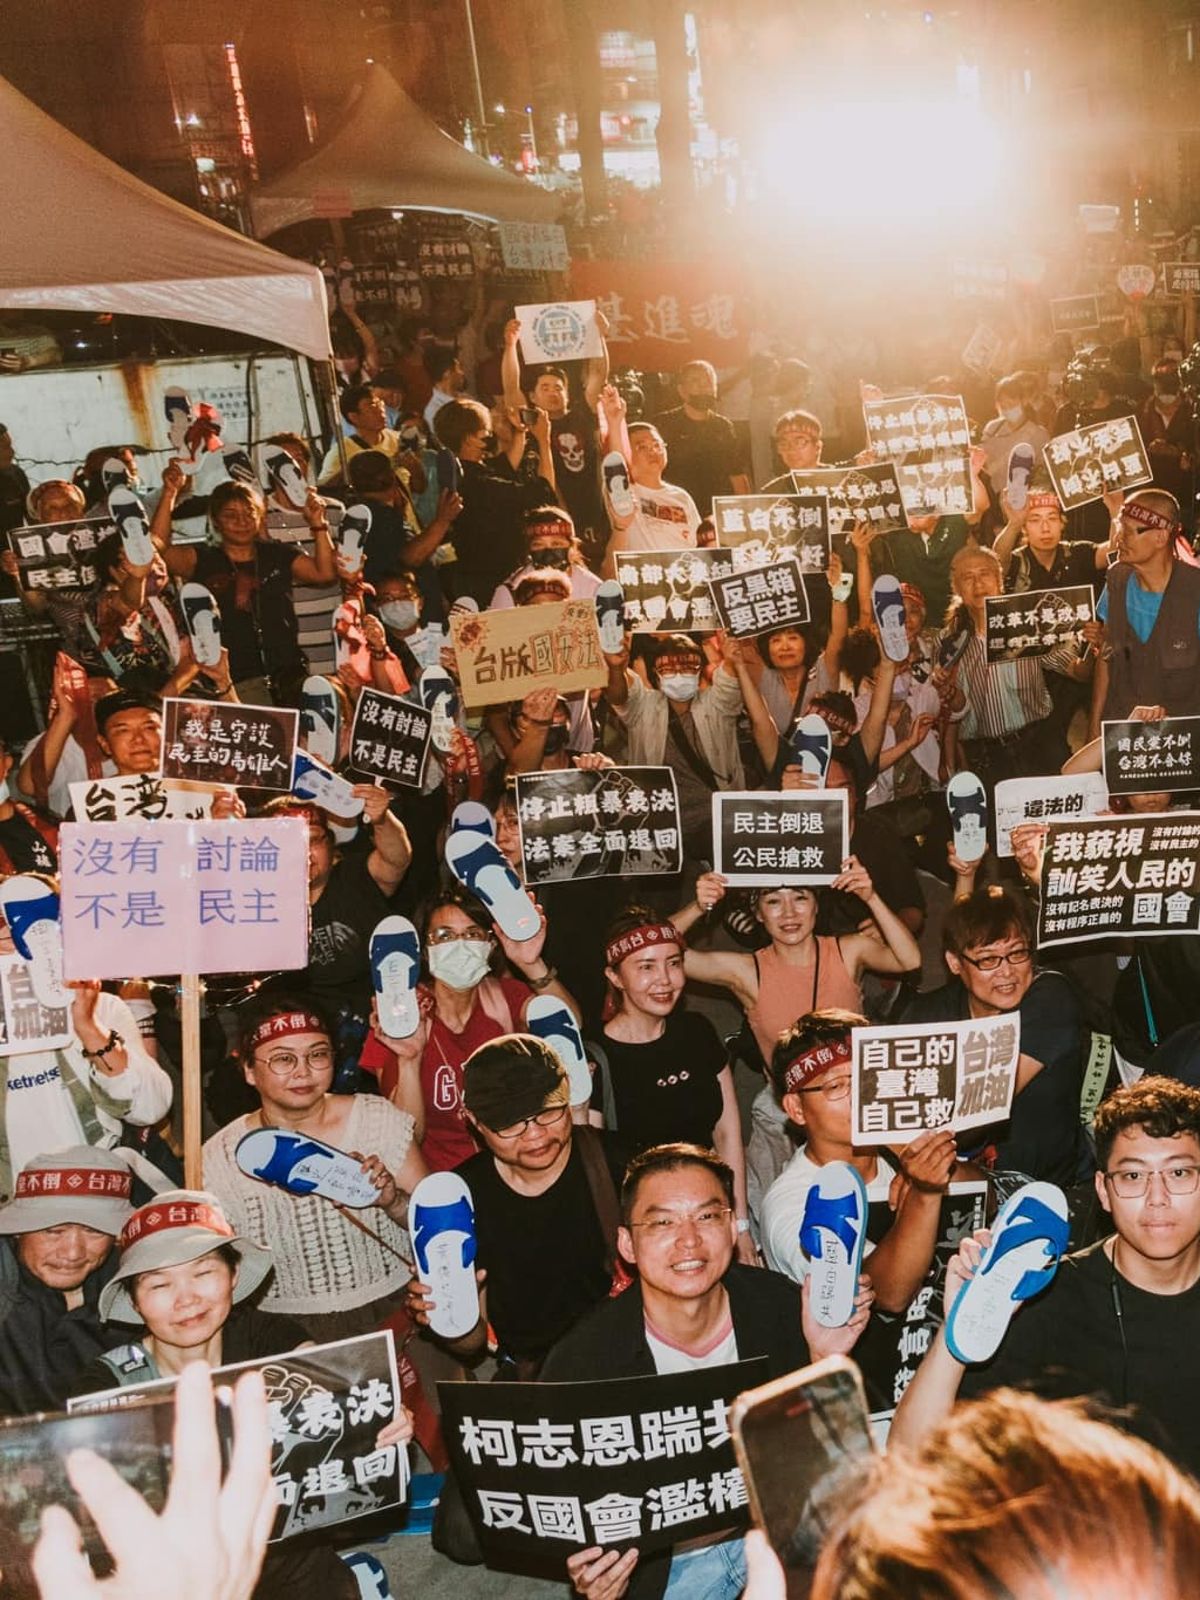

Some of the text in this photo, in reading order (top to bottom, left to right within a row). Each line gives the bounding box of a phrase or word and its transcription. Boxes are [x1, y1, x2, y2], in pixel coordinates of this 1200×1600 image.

[721, 567, 797, 609] 反黑箱
[728, 597, 801, 635] 要民主
[184, 718, 274, 749] 我是守護
[362, 700, 428, 741] 沒有討論
[168, 743, 288, 775] 民主的高雄人
[354, 738, 420, 777] 不是民主
[520, 788, 676, 822] 停止粗暴表決
[1024, 793, 1084, 818] 違法的
[733, 812, 825, 835] 民主倒退
[73, 836, 163, 876] 沒有
[197, 836, 281, 873] 討論
[524, 828, 678, 861] 法案全面退回
[733, 846, 825, 869] 公民搶救
[1052, 828, 1145, 863] 我藐視
[1150, 838, 1200, 851] 沒有民主的
[1046, 857, 1197, 898] 訕笑人民的
[74, 889, 280, 930] 不是 民主
[1044, 911, 1122, 933] 沒有程序正義的
[1045, 895, 1125, 916] 沒有記名表決的
[1131, 891, 1195, 926] 國會
[862, 1036, 955, 1069] 自己的
[961, 1024, 1016, 1076] 台灣
[875, 1069, 940, 1099] 臺灣
[956, 1073, 1012, 1118] 加油
[862, 1100, 954, 1132] 自己救
[477, 1467, 750, 1546] 反國會濫權
